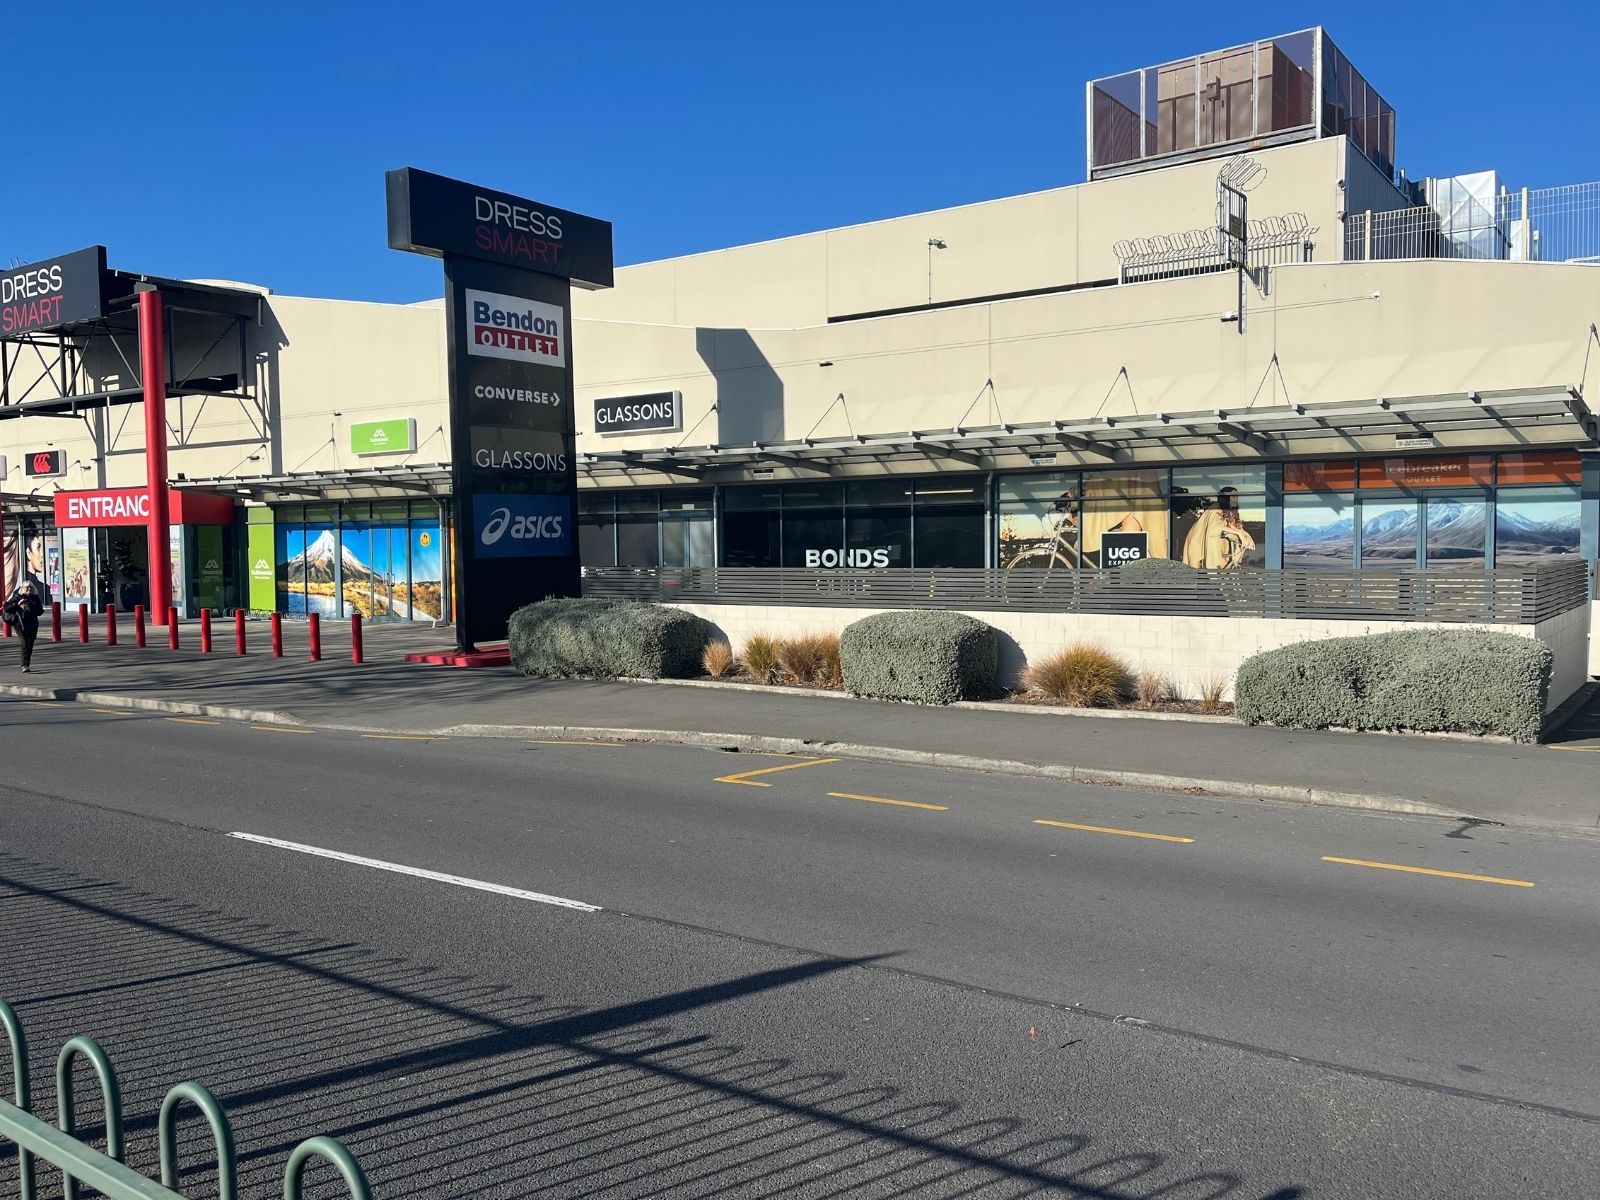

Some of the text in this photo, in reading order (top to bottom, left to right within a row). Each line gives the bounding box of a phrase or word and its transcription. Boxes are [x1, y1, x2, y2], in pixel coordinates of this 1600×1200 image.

[475, 195, 562, 240] DRESS
[475, 225, 563, 264] SMART
[2, 265, 63, 304] DRESS
[3, 294, 64, 332] SMART
[473, 300, 558, 336] Bendon
[481, 330, 554, 355] OUTLET
[474, 385, 549, 405] CONVERSE
[596, 402, 672, 424] GLASSONS
[475, 448, 566, 472] GLASSONS
[1407, 475, 1441, 483] OUTLET
[68, 494, 149, 519] ENTRANC
[805, 548, 889, 568] BONDS
[1108, 547, 1140, 559] UGG
